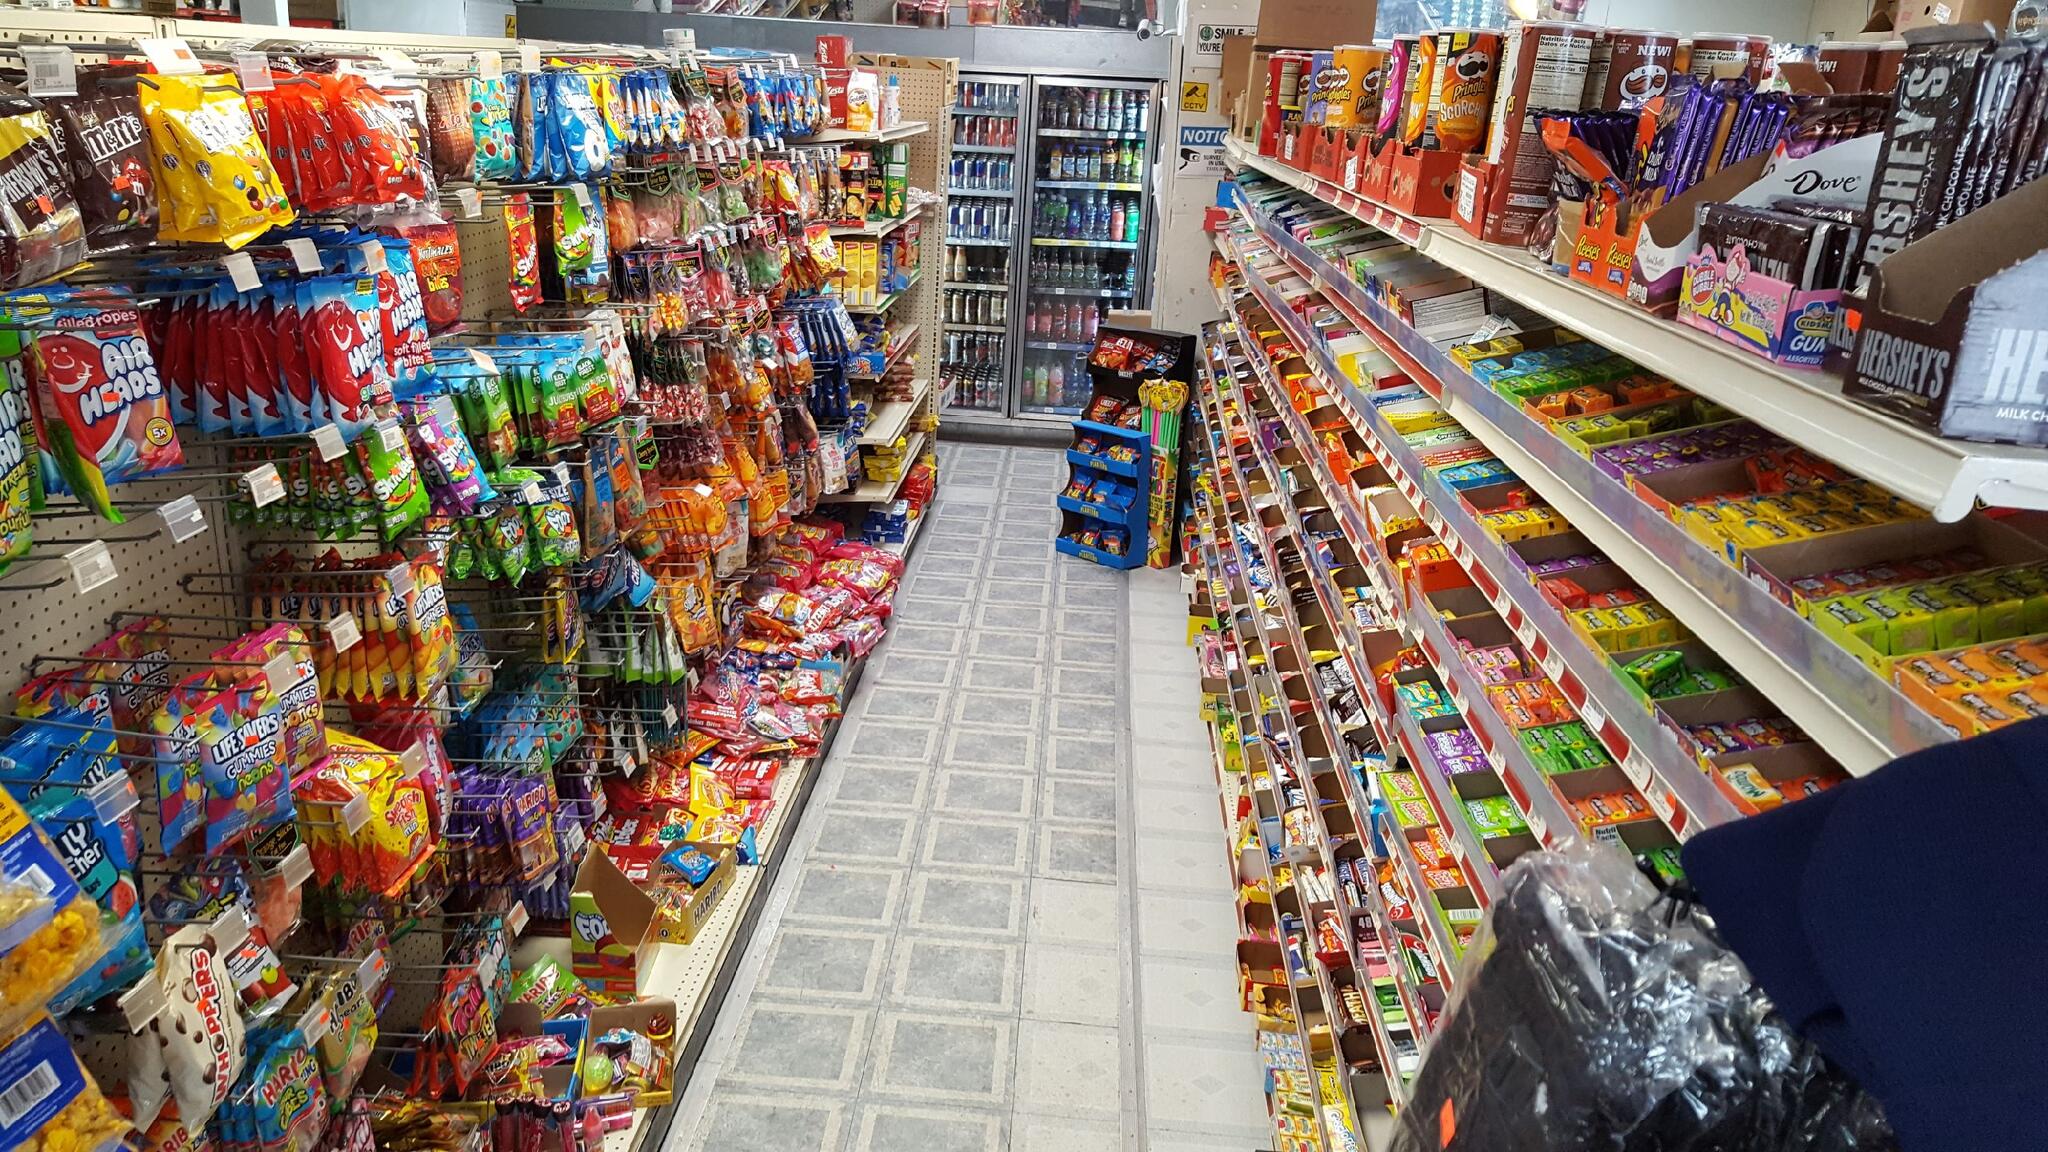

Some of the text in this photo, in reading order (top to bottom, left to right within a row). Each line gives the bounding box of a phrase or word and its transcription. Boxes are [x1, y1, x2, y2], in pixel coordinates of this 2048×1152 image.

[1199, 42, 1221, 52] YOU'RE
[1637, 45, 1672, 57] NEW!
[1818, 60, 1837, 72] EW!
[1184, 102, 1204, 110] CCTV
[1183, 129, 1228, 144] NOTIC
[1576, 235, 1600, 260] Reese's
[1606, 242, 1633, 269] Reese's
[1692, 269, 1715, 285] DUBBLE
[1692, 280, 1715, 296] BUBBLE
[96, 308, 138, 328] ropes
[102, 336, 154, 380] AIR
[393, 339, 431, 356] soft filled
[403, 355, 425, 367] bites
[1856, 328, 1950, 400] HERSHEY'S
[79, 365, 163, 426] HEADS
[1995, 408, 2030, 421] MILK
[279, 685, 317, 712] UMMIES
[284, 702, 320, 729] XOTICS
[225, 740, 277, 780] GUMMIES
[237, 760, 275, 793] neons
[515, 784, 546, 817] HARIBO
[69, 841, 103, 878] cher
[575, 913, 611, 943] FOO
[1358, 917, 1372, 929] 48
[190, 947, 232, 1106] WHOPPERS
[261, 1044, 309, 1109] HARIO
